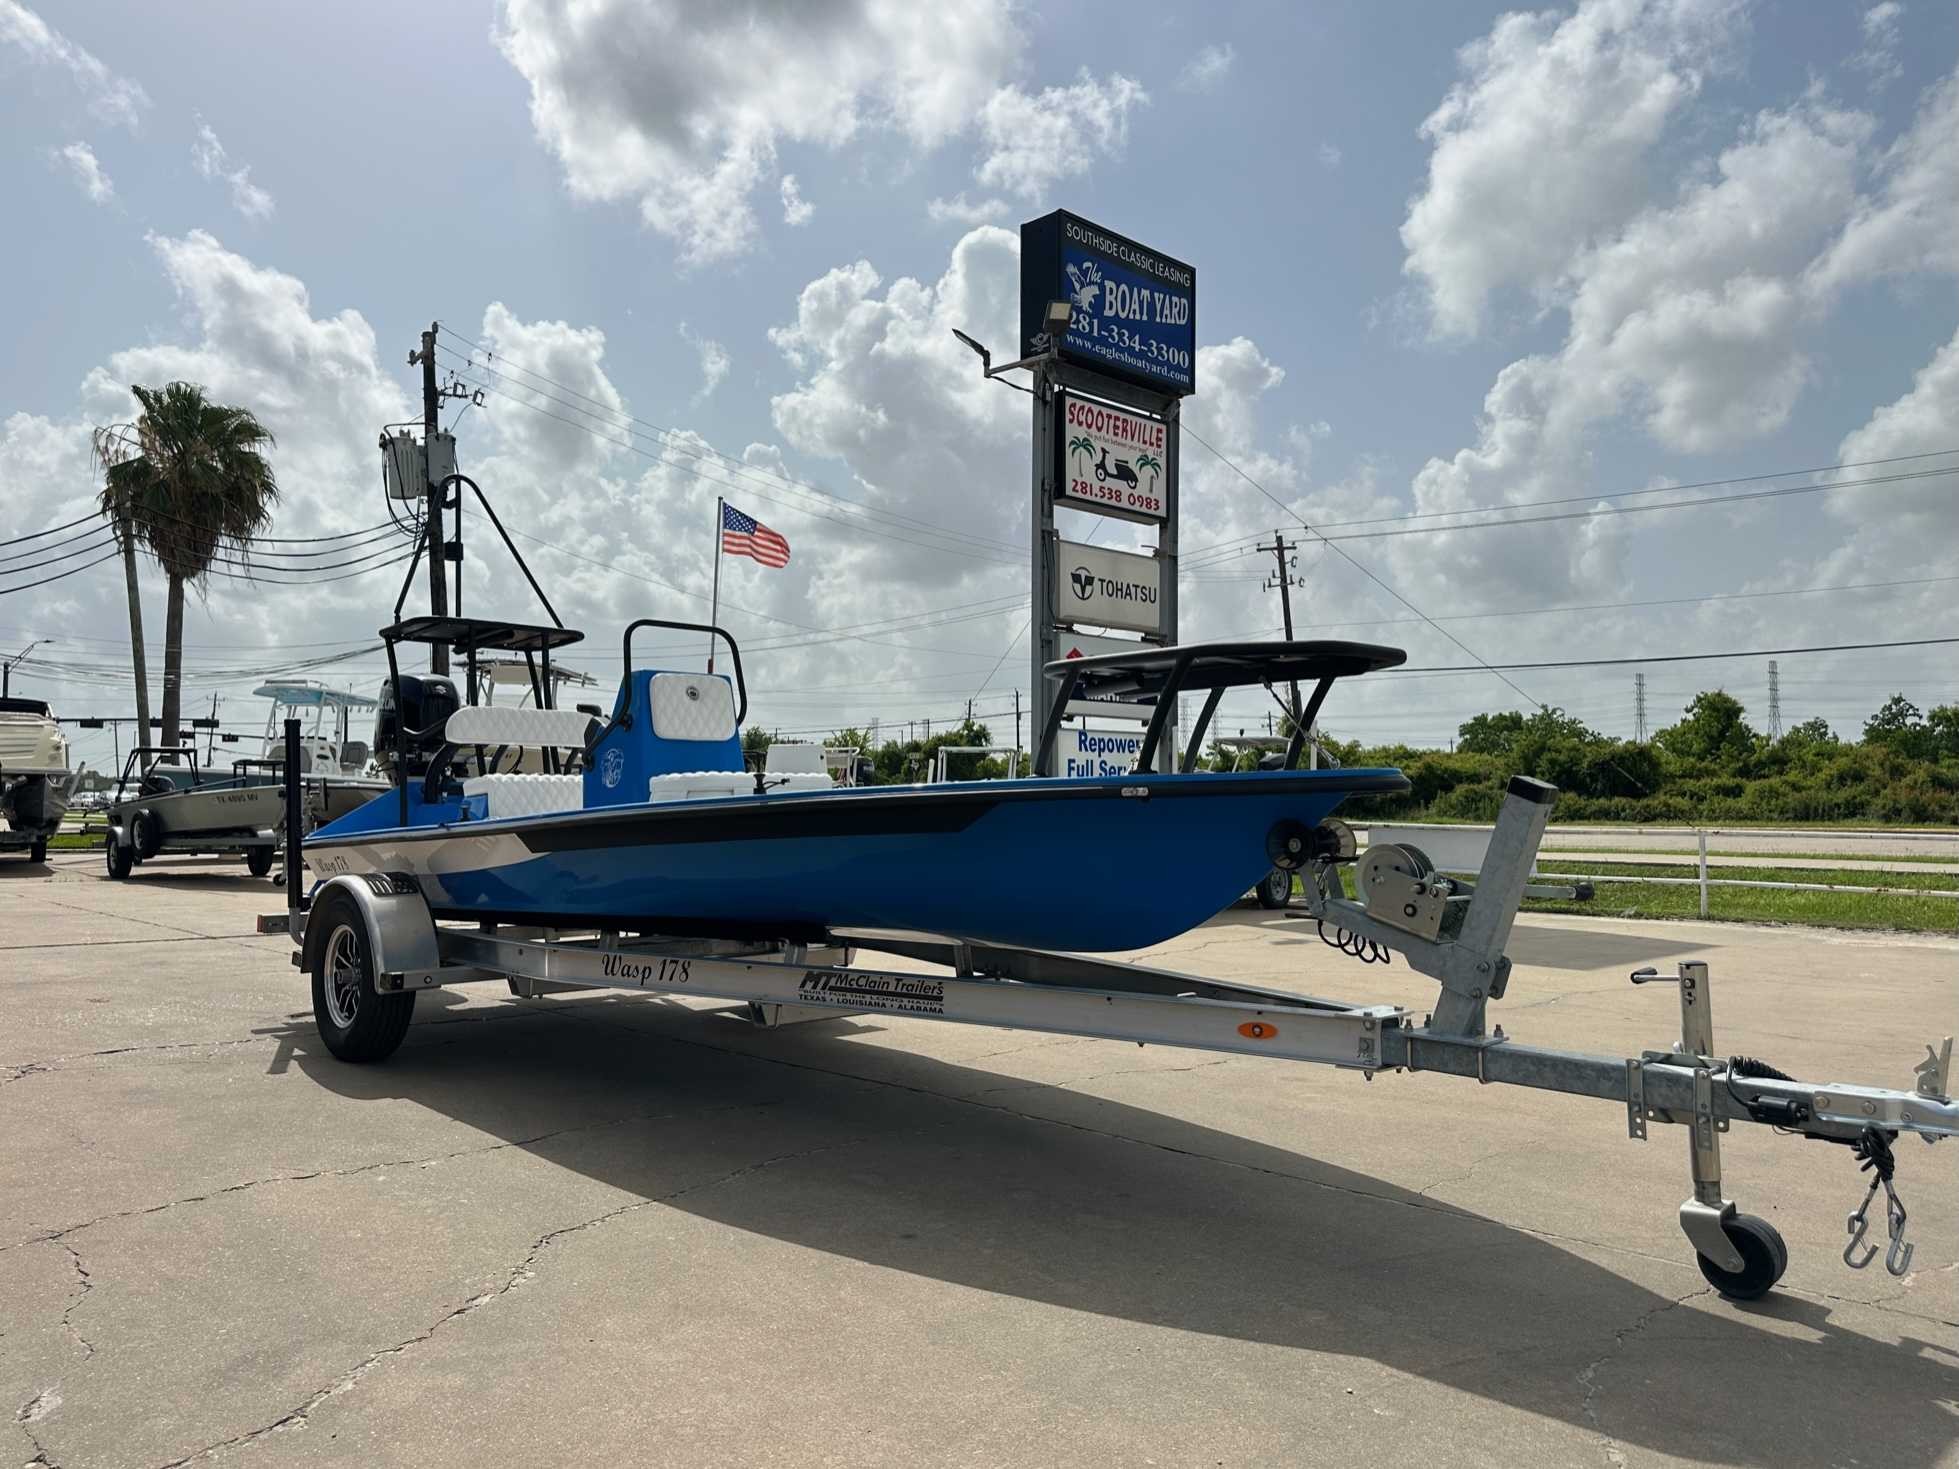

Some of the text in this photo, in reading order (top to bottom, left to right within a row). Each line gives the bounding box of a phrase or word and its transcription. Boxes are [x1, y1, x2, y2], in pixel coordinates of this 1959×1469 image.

[1066, 223, 1191, 287] SOUTHSIDE CLASSIC LEASING
[1082, 261, 1102, 283] The
[1103, 279, 1189, 325] BOAT YARD
[1070, 310, 1190, 369] 281-334-3300
[1066, 333, 1190, 384] www.eaglesboatyard.com
[1068, 402, 1163, 449] SCOOTERVILLE
[1071, 479, 1160, 511] 281.538 0983
[1098, 578, 1157, 604] TOHATSU
[1067, 758, 1094, 778] Full
[601, 953, 692, 987] Wasp 178
[834, 973, 890, 990] McClain
[800, 993, 944, 1015] TEXAS LOUISIANA ALABAMA
